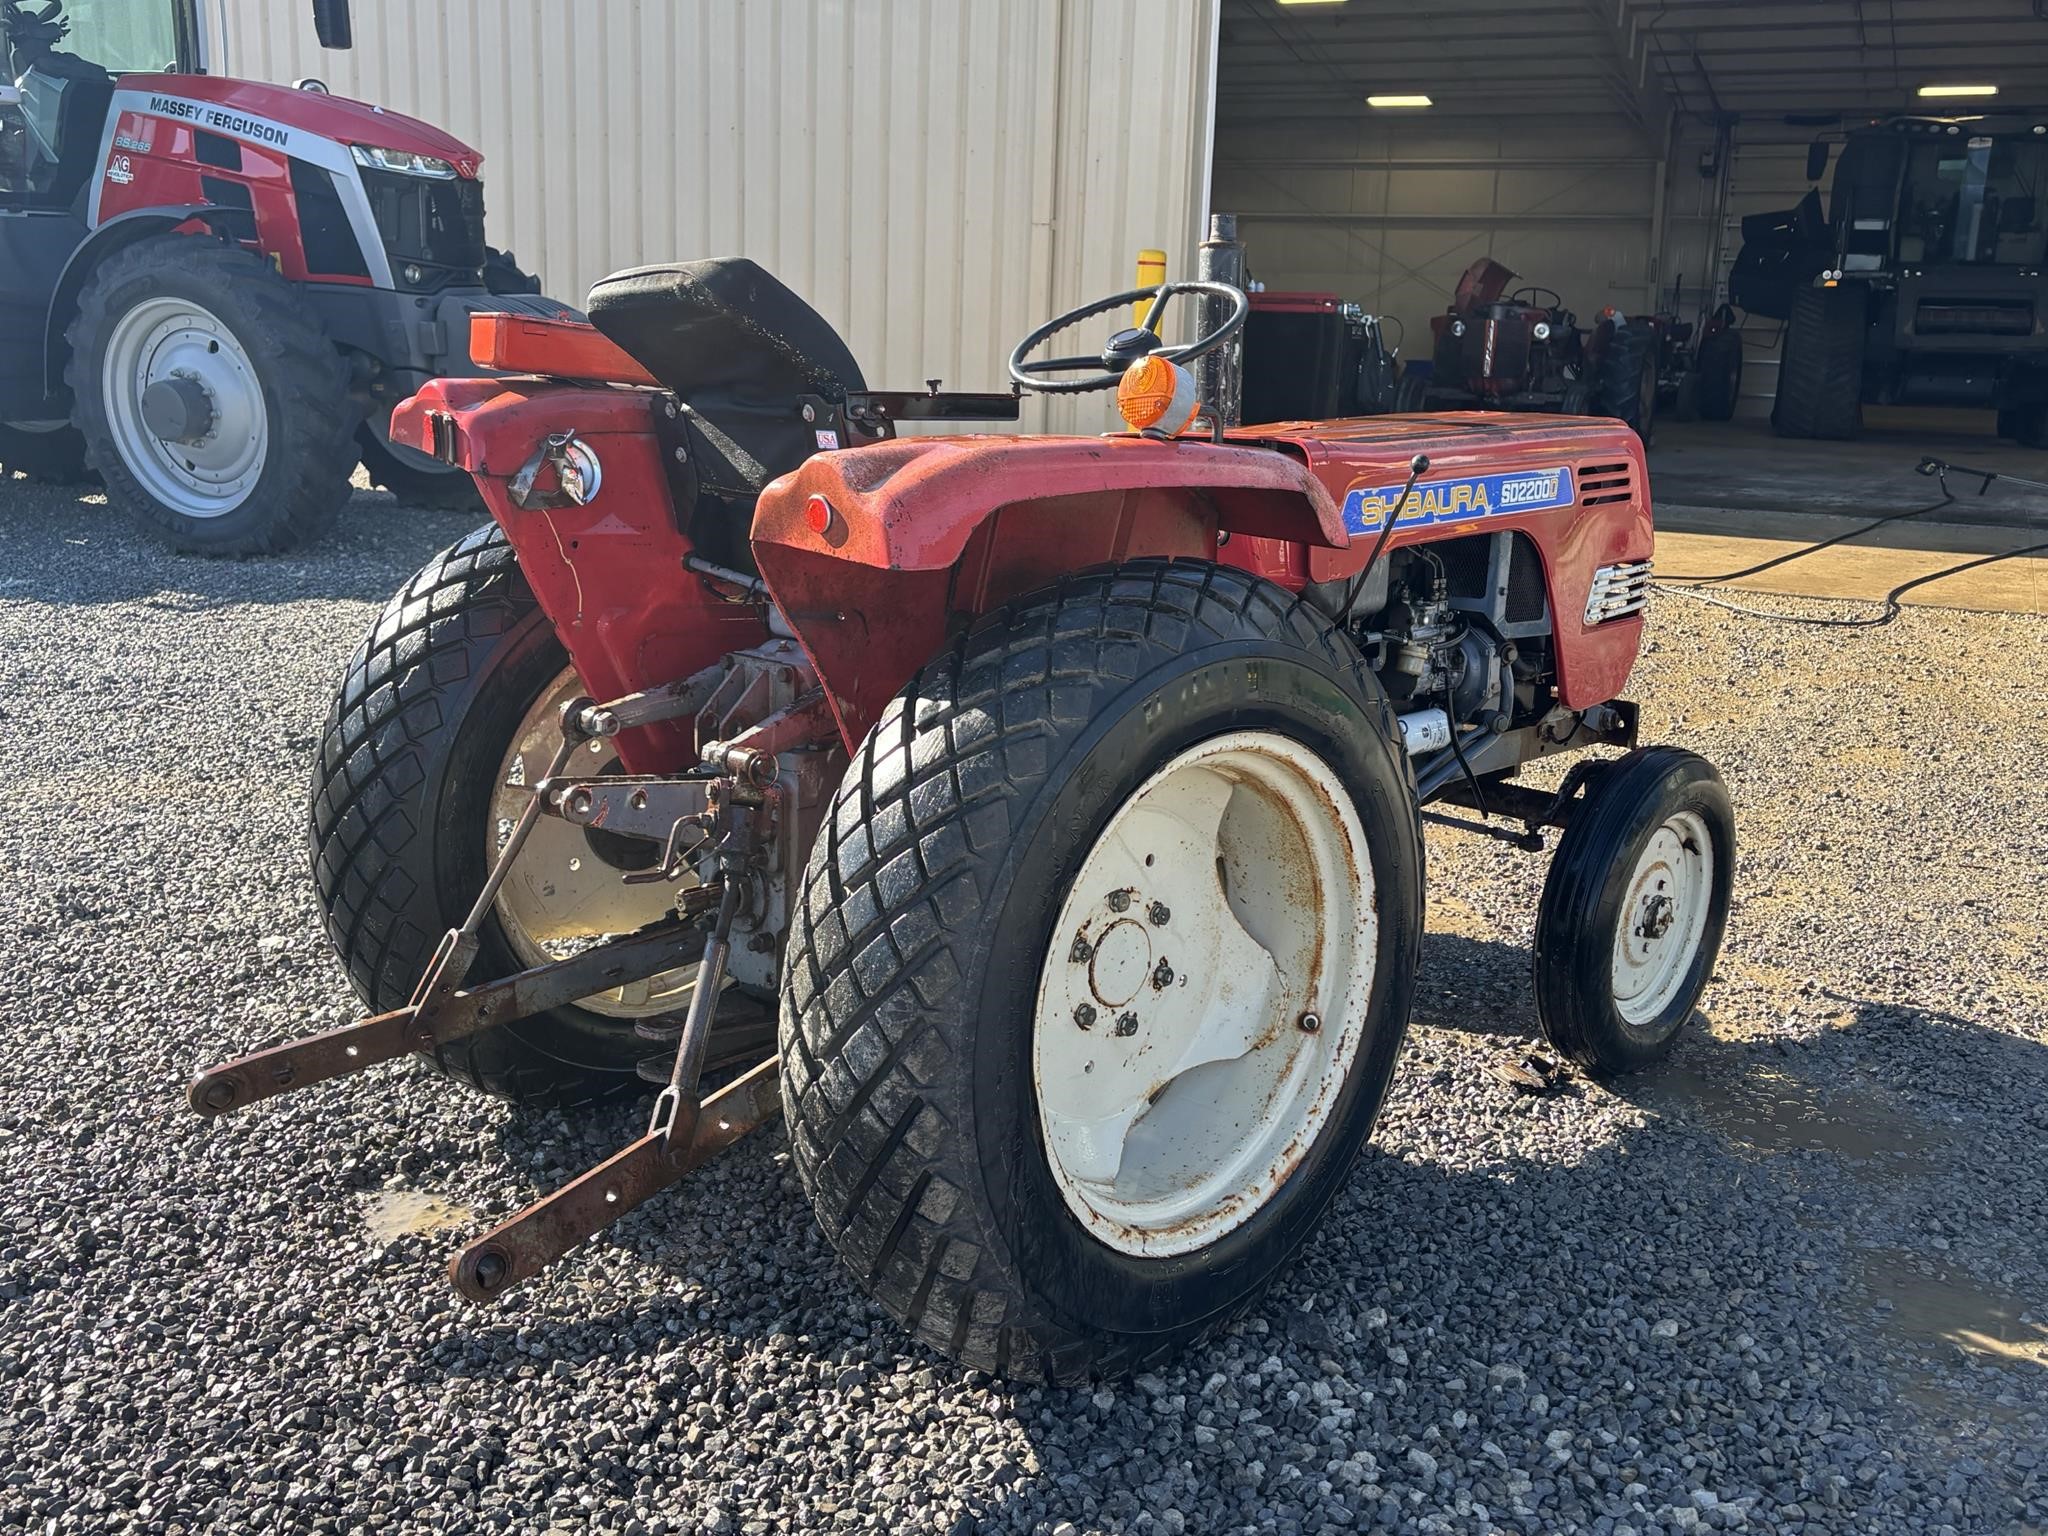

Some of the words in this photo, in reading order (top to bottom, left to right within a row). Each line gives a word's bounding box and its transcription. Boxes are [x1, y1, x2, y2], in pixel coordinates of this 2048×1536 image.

[150, 97, 203, 120] MASSEY
[206, 110, 289, 146] FERGUSON
[112, 156, 129, 172] AG
[818, 434, 835, 445] USA
[1362, 483, 1489, 525] SHIBAURA
